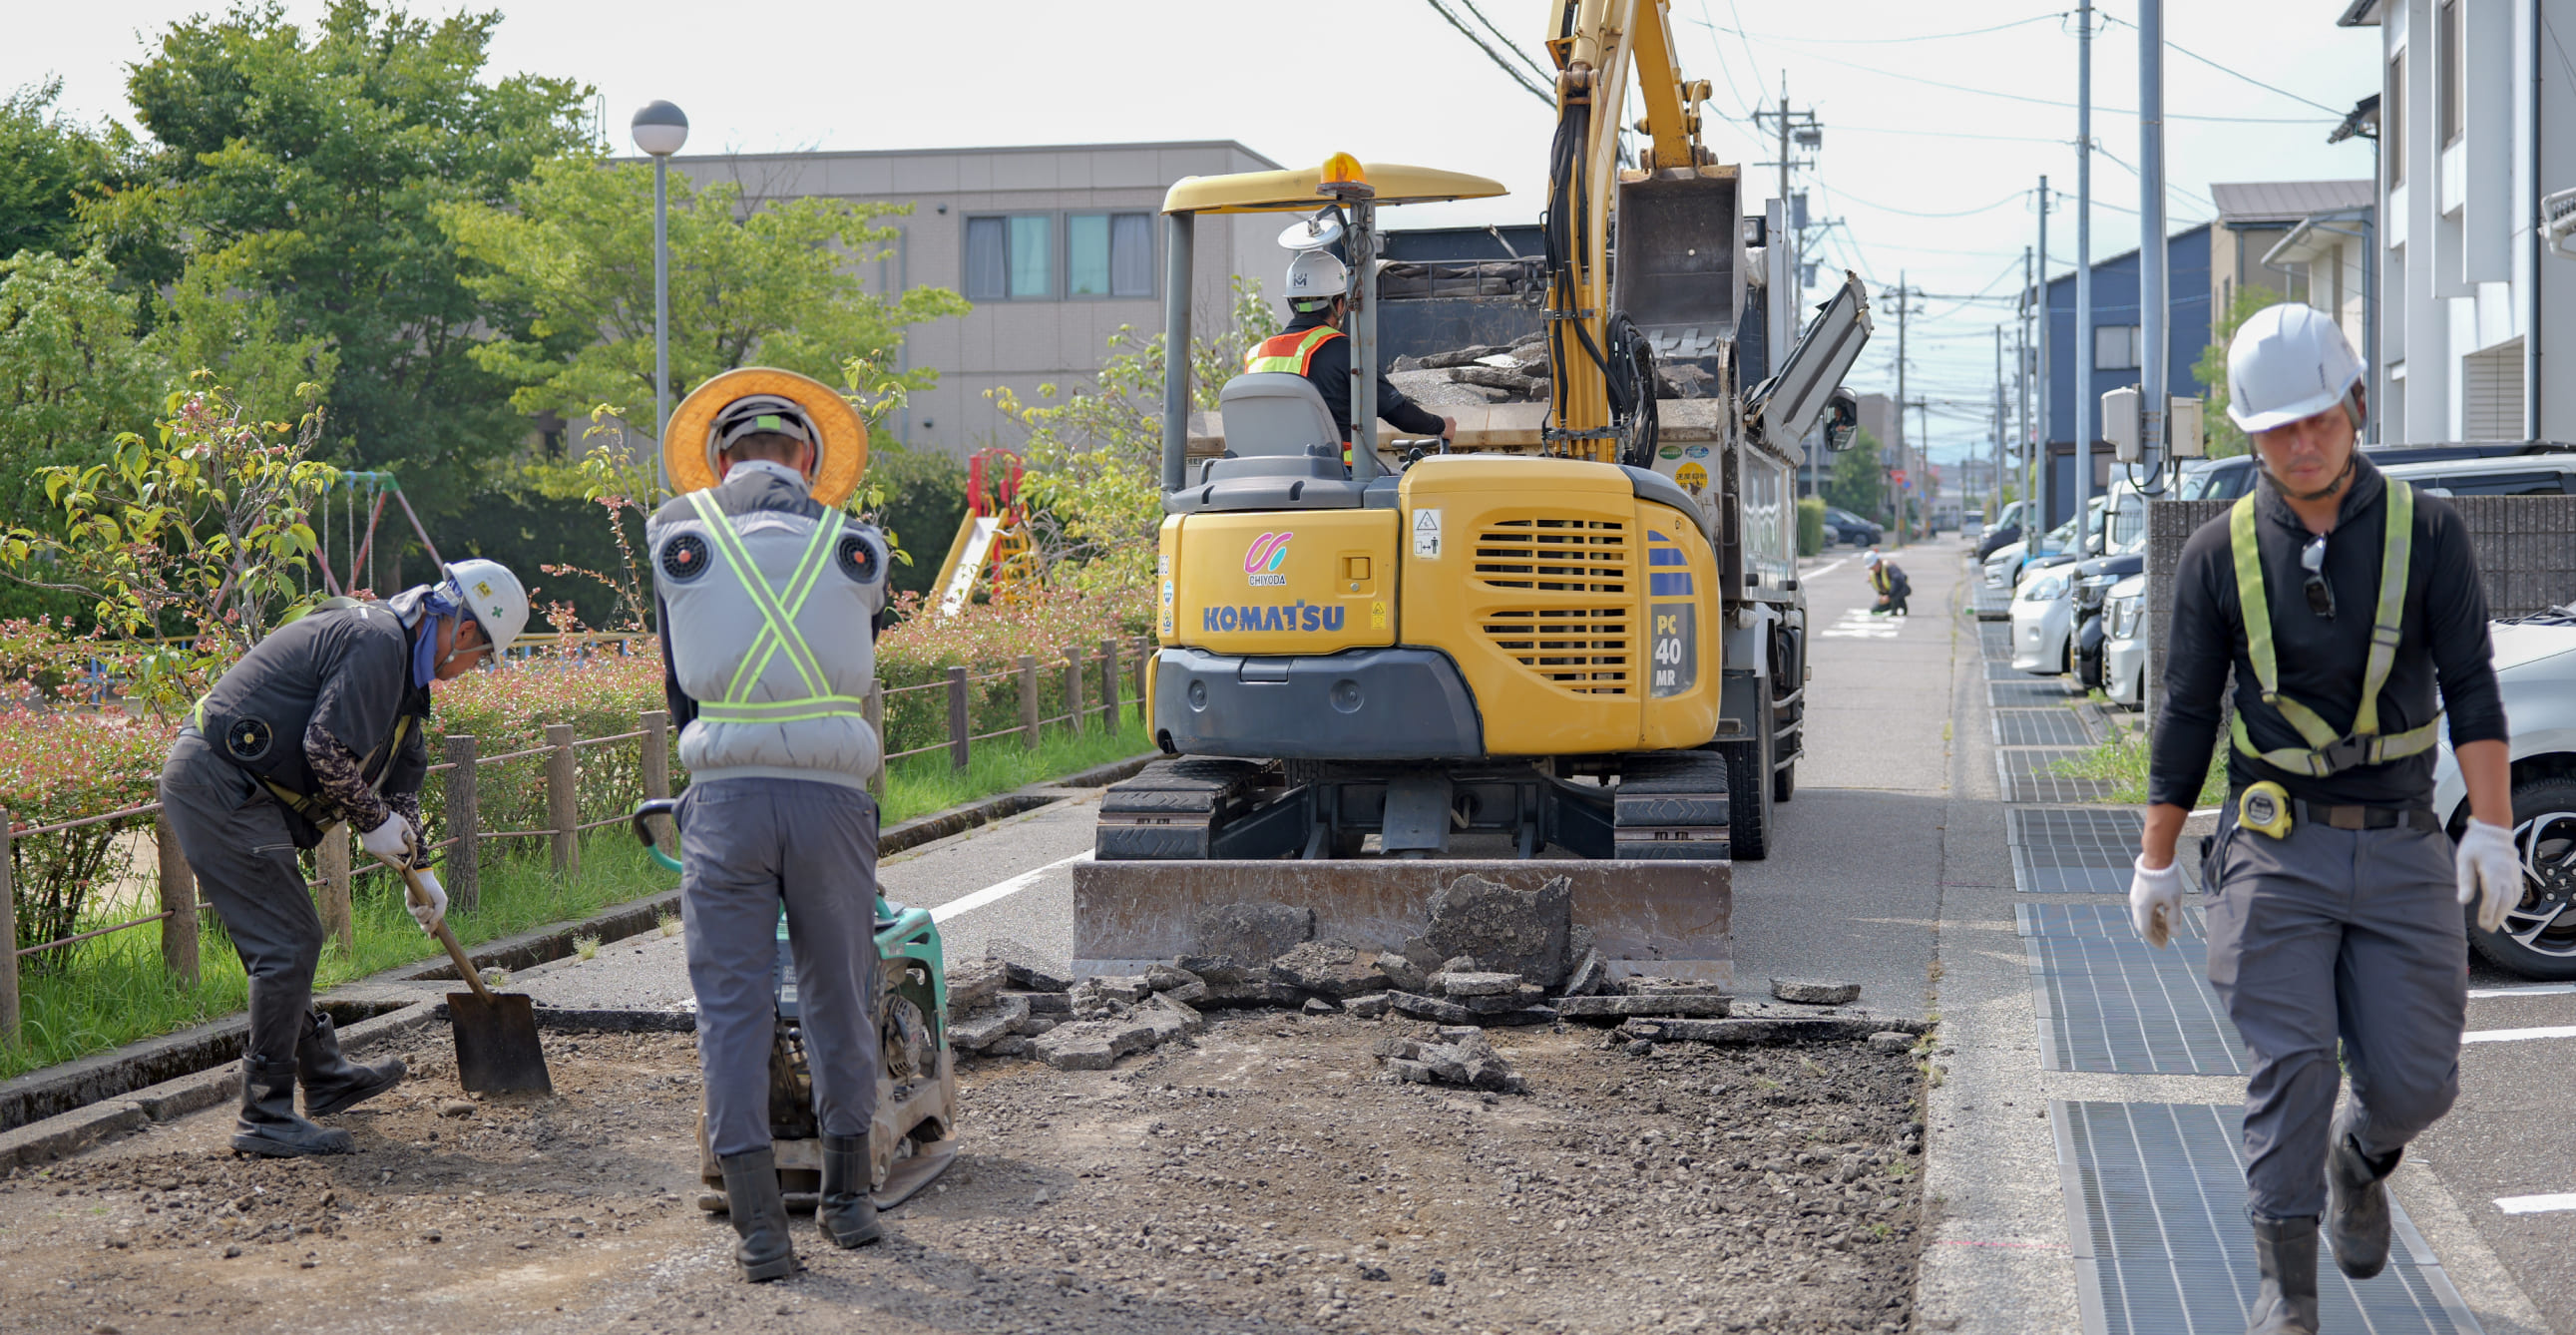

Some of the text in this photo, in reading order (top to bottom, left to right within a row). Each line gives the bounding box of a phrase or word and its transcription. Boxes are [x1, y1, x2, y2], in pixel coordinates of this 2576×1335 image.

[1249, 575, 1286, 586] CHIYODA
[1202, 599, 1345, 632] KOMATSU
[1657, 615, 1677, 635] PC
[1655, 638, 1682, 665] 40
[1656, 669, 1676, 686] MR
